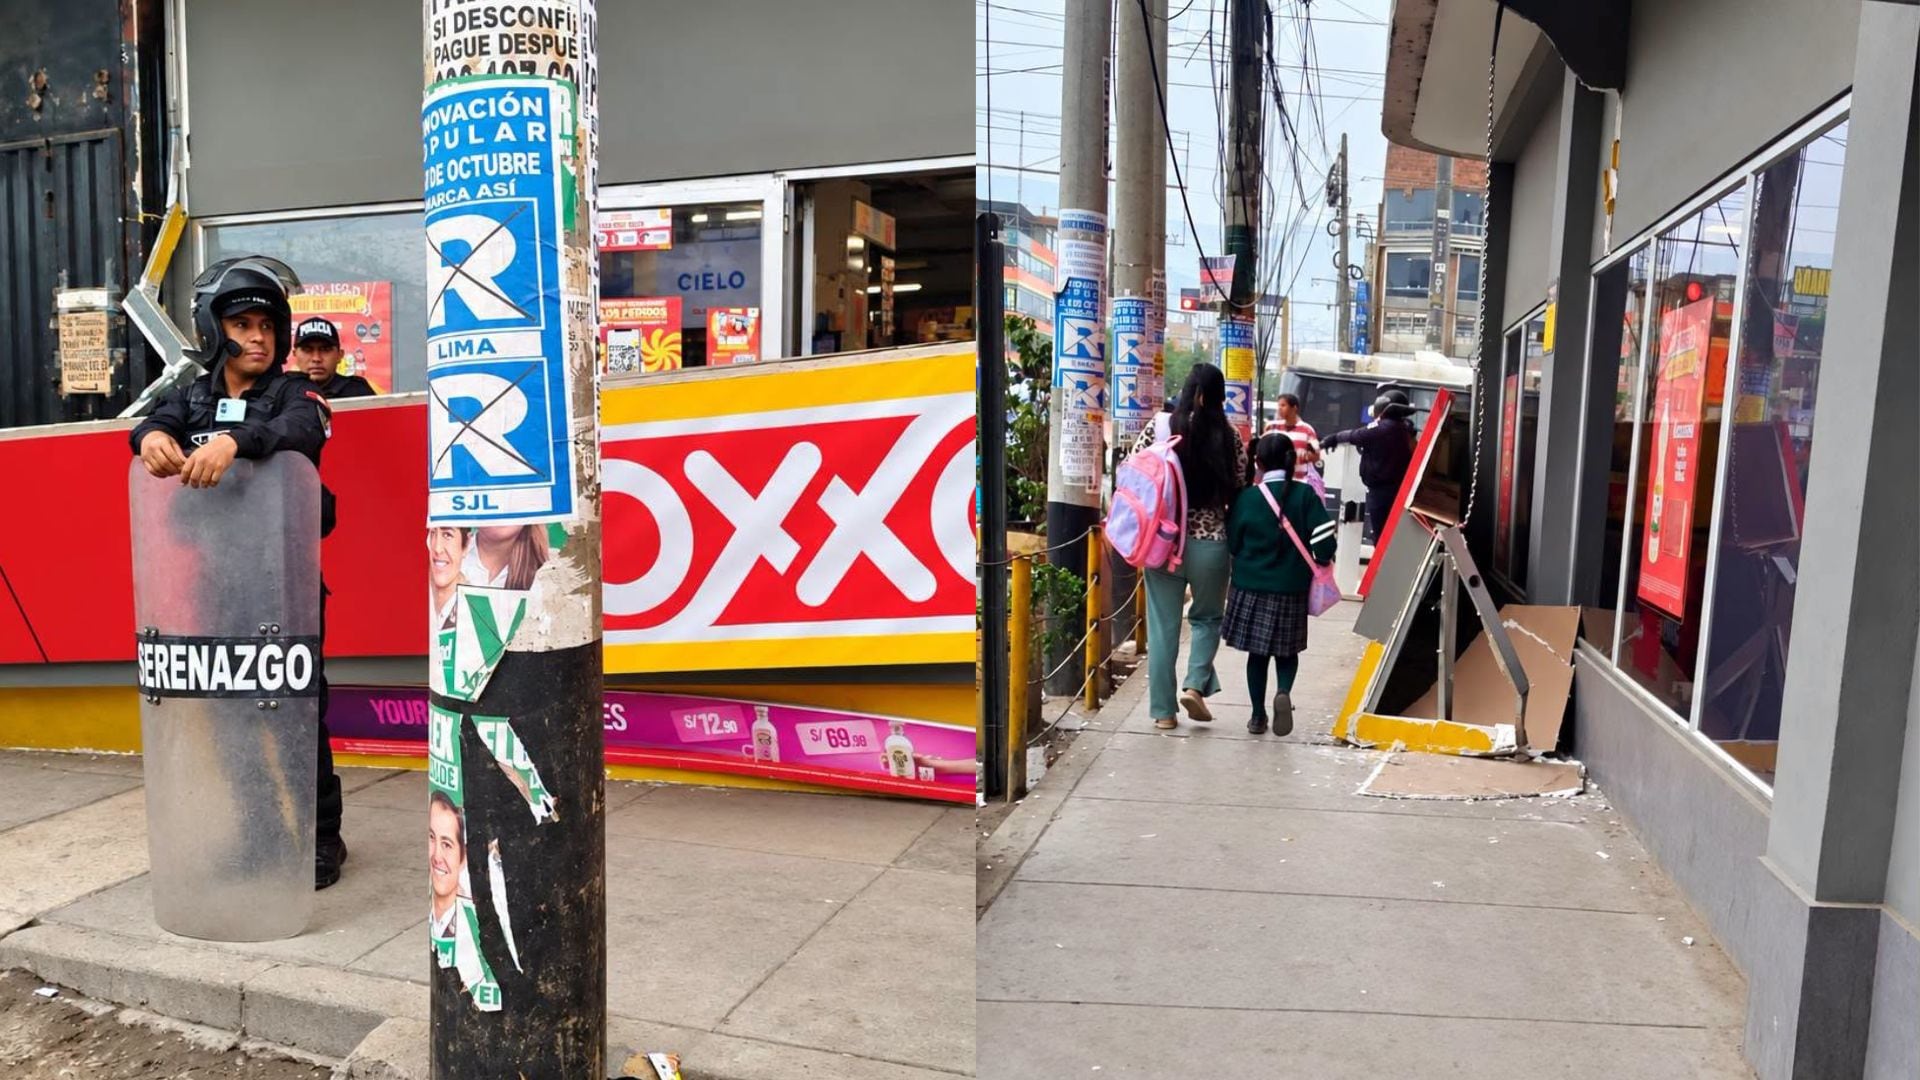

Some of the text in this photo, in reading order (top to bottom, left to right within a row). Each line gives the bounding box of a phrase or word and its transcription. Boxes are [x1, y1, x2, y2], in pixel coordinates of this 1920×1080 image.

[433, 16, 446, 41] SI
[434, 34, 491, 68] PAGUE
[447, 152, 541, 182] OCTUBRE
[476, 179, 515, 199] ASÍ
[426, 214, 527, 330] R
[677, 270, 746, 292] CIELO
[299, 321, 333, 337] POLICIA
[438, 338, 497, 359] LIMA
[429, 373, 541, 480] R
[452, 495, 499, 511] SJL
[138, 643, 313, 691] SERENAZGO
